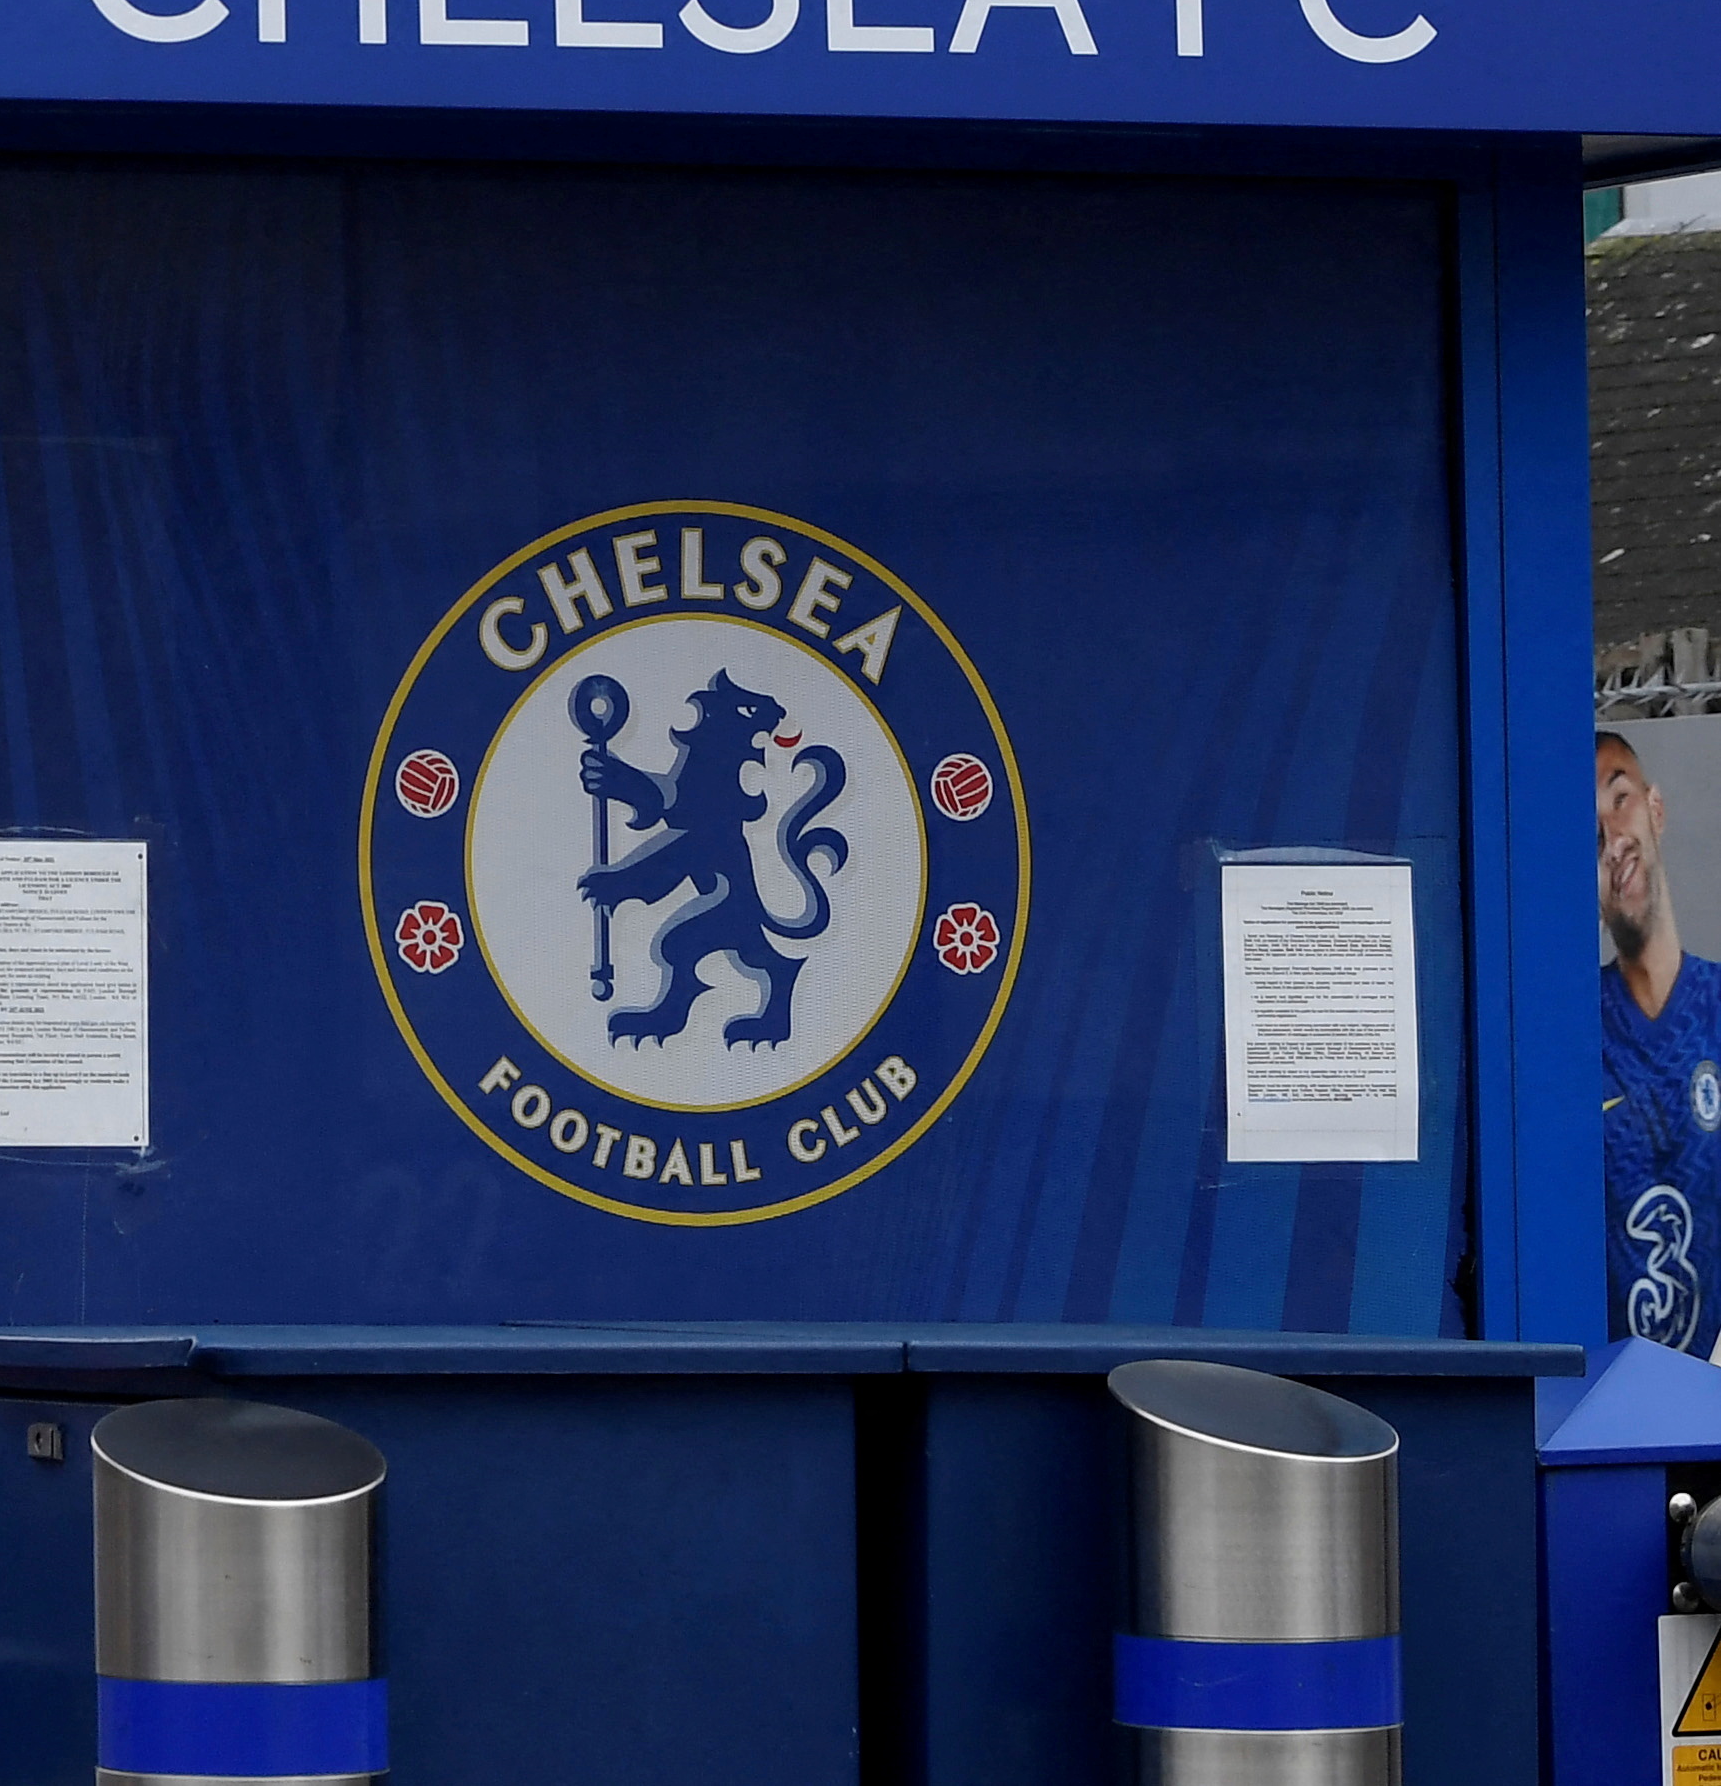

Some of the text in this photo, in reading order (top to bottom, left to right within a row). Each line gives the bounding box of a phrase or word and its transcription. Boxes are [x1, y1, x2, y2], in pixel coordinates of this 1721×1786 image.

[477, 525, 904, 687] CHELSEA
[477, 1052, 919, 1188] FOOTBALL CLUB
